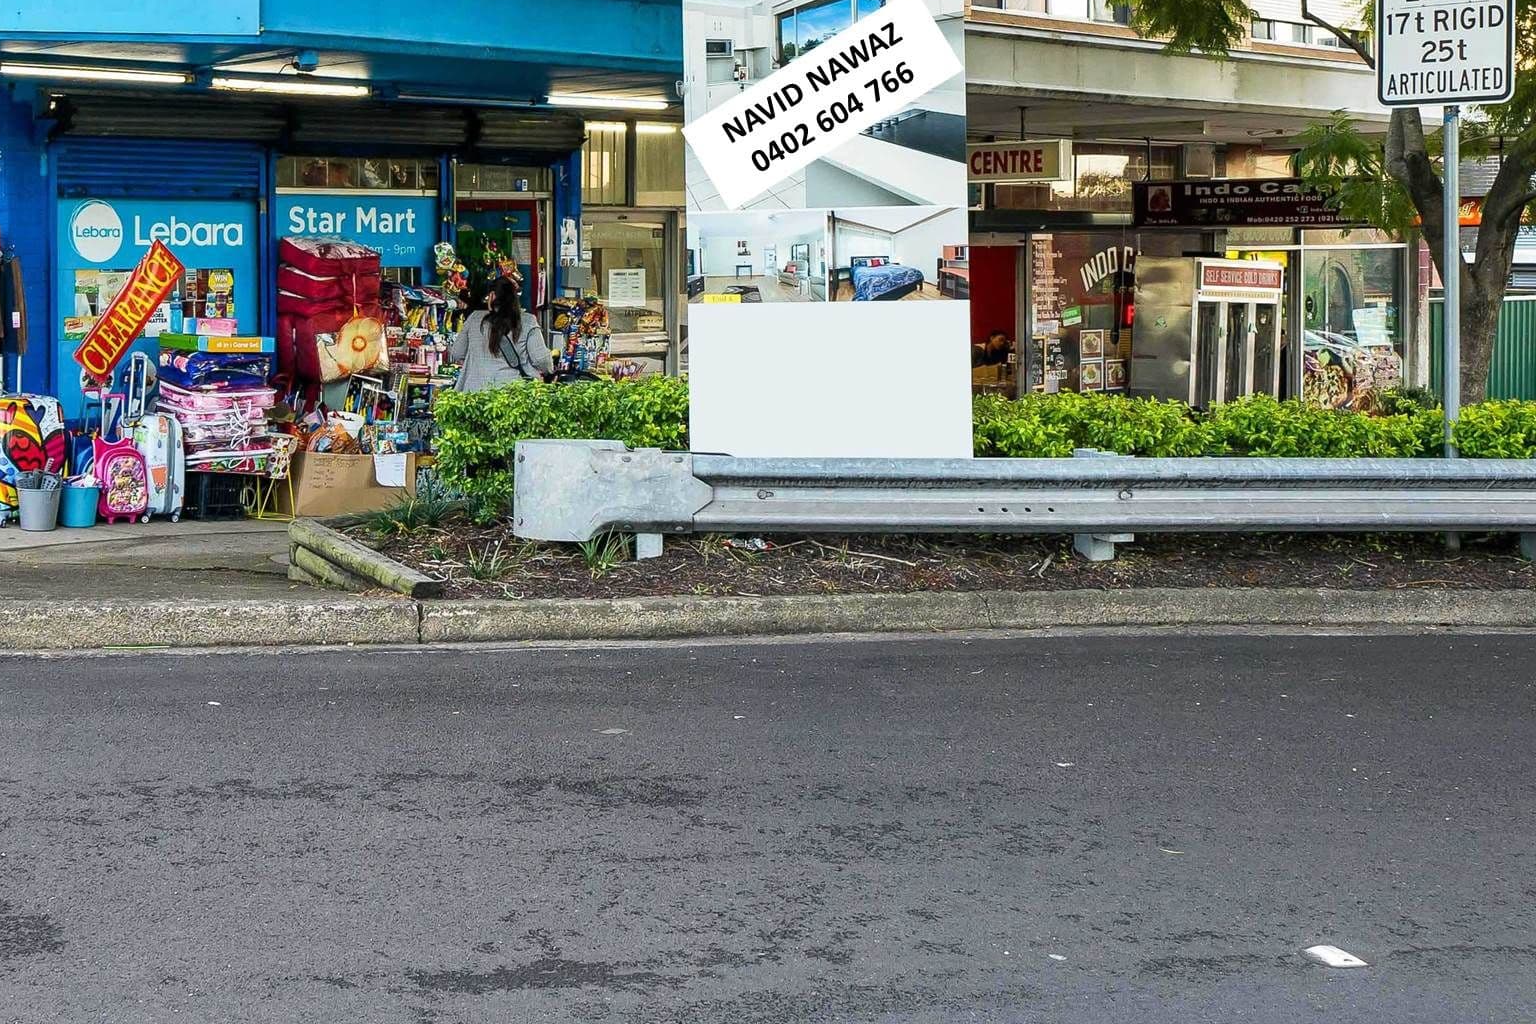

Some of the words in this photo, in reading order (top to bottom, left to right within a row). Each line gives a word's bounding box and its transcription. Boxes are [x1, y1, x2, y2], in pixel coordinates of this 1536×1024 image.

[1386, 11, 1425, 36] 17t
[1433, 4, 1504, 33] RIGID
[1421, 38, 1468, 64] 25t
[1387, 67, 1503, 96] ARTICULATED
[970, 149, 1043, 175] CENTRE
[1183, 183, 1249, 196] Indo
[1226, 196, 1253, 204] INDIAN
[1253, 195, 1300, 203] AUTHENTIC
[75, 226, 121, 238] Lebara
[134, 215, 243, 247] Lebara
[288, 205, 346, 234] Star
[356, 206, 416, 234] Mart
[393, 244, 416, 257] 9pm
[1079, 246, 1118, 292] INDO
[1205, 269, 1219, 282] SELF
[1220, 270, 1243, 284] SERVICE
[81, 248, 180, 376] CLEARANCE
